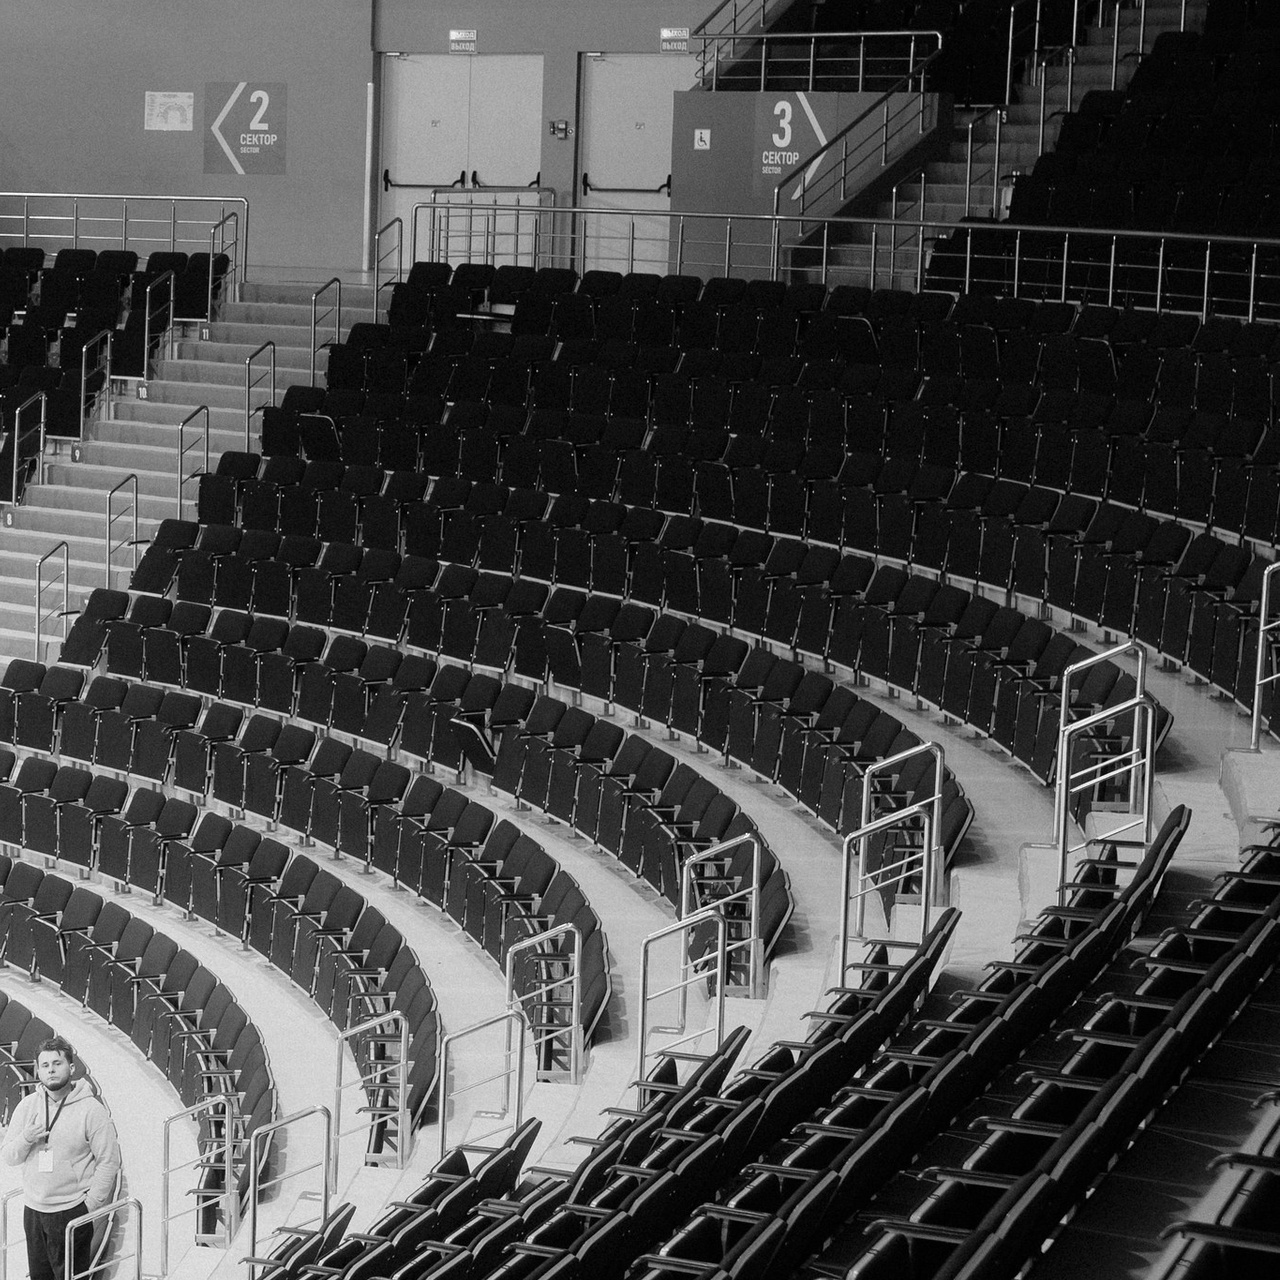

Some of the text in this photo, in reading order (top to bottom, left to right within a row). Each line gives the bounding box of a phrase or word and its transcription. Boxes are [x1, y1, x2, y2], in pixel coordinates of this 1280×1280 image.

[451, 42, 475, 51] ВЫХОД
[662, 41, 687, 51] ВЫХОД
[249, 90, 269, 130] 2
[772, 100, 792, 148] 3
[240, 133, 277, 146] СЕКТОР
[762, 151, 799, 165] СЕКТОР
[762, 166, 782, 174] SECTOR
[138, 387, 147, 398] 10
[74, 449, 81, 461] 9
[6, 514, 12, 526] 8
